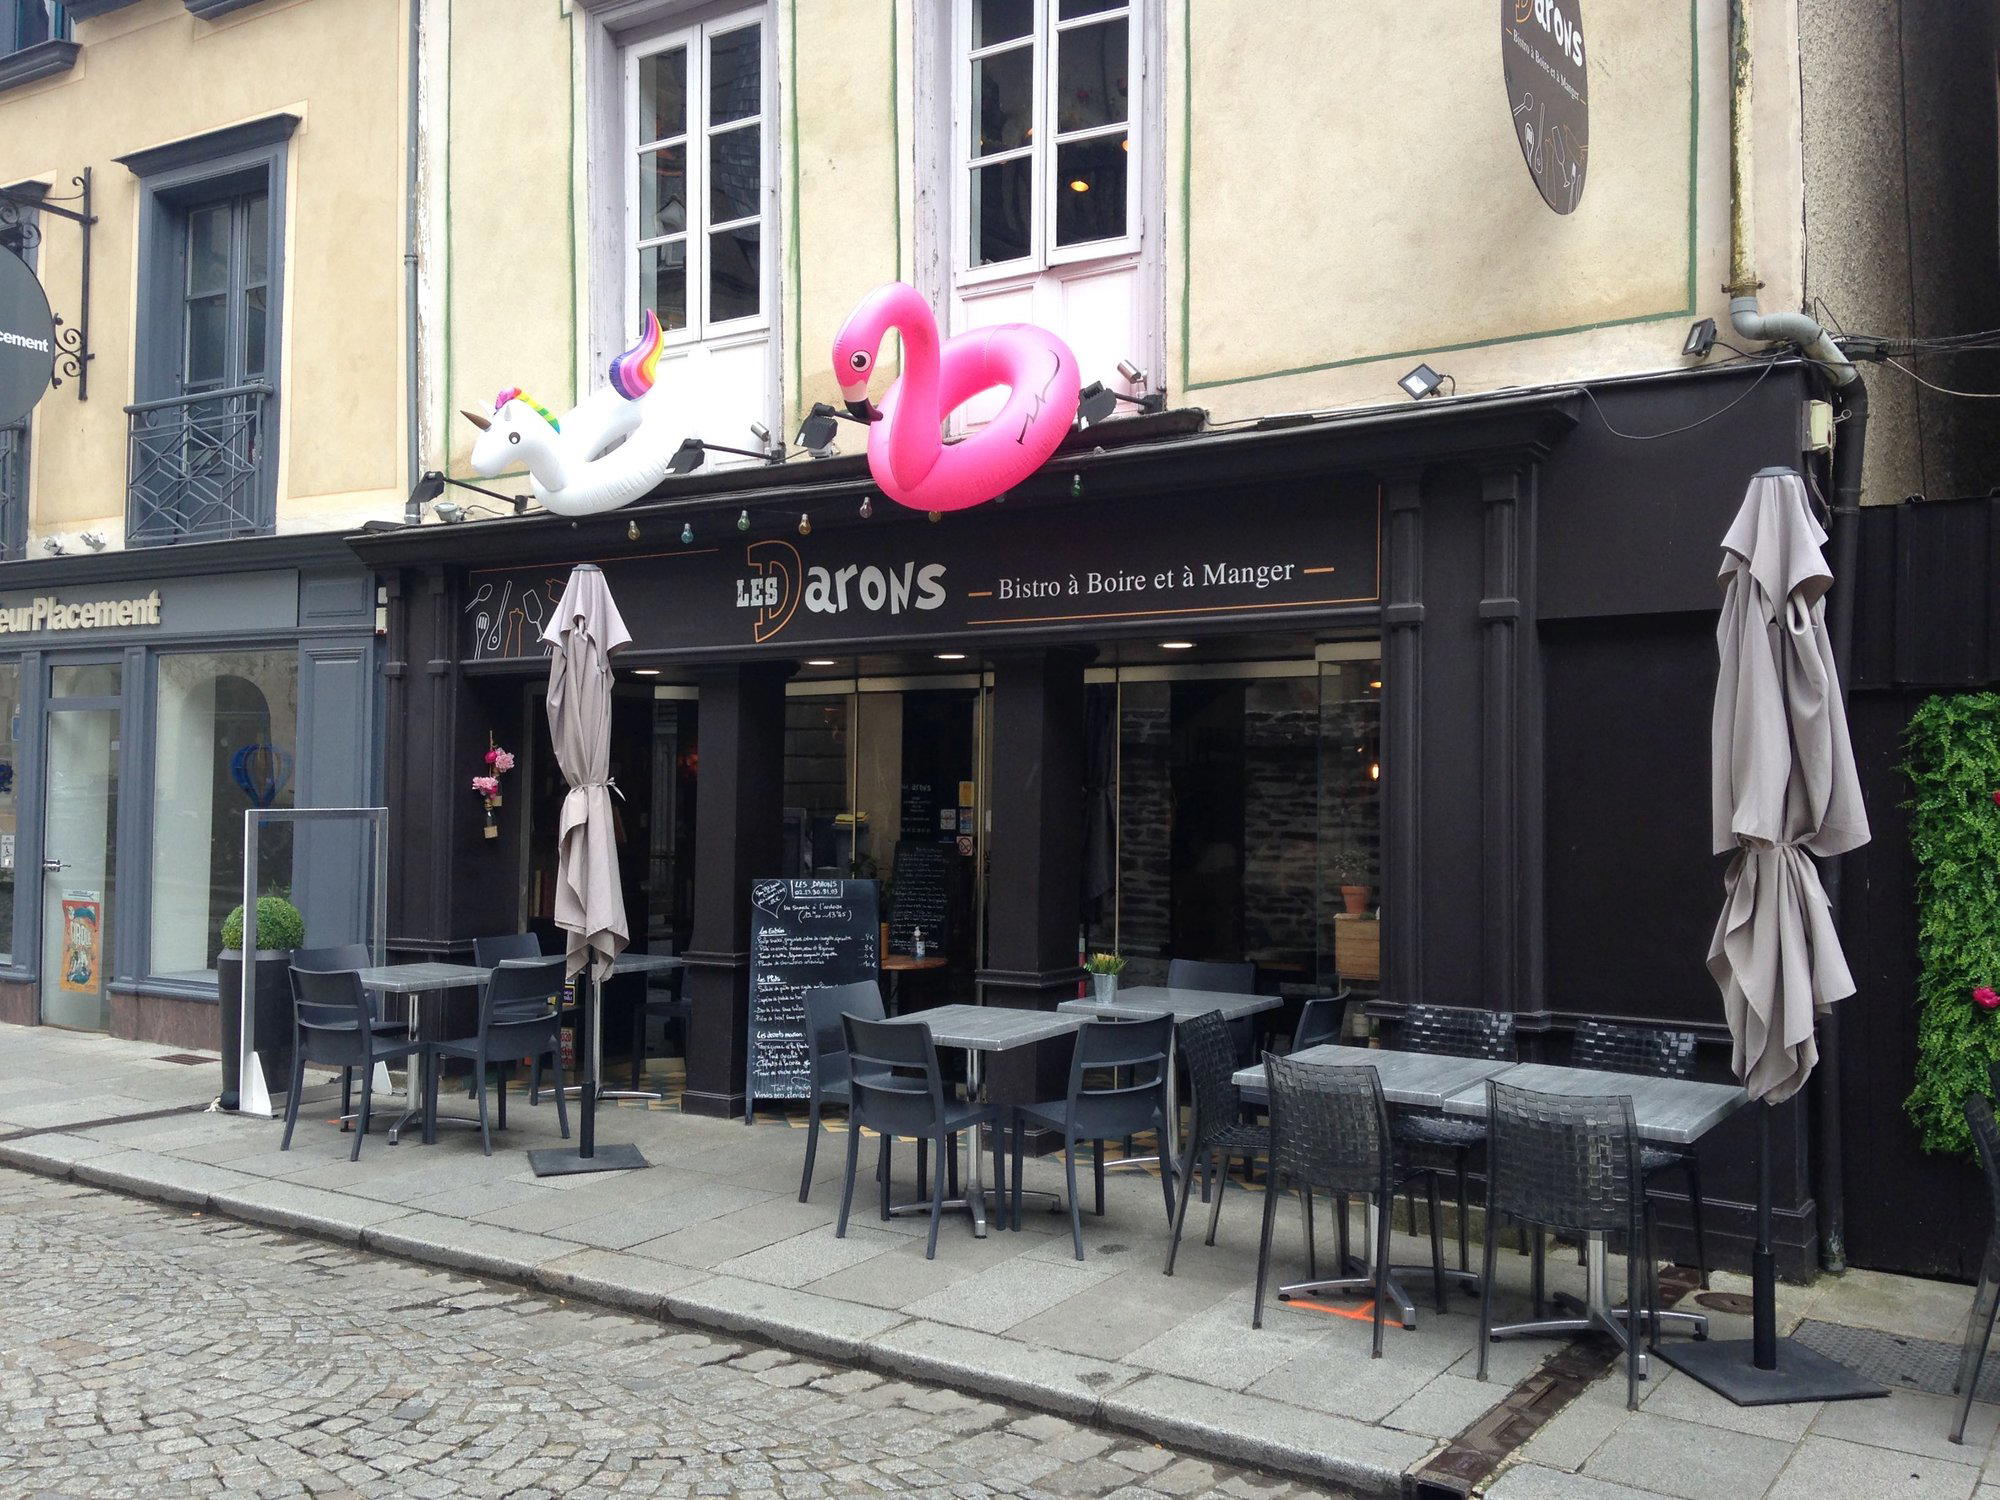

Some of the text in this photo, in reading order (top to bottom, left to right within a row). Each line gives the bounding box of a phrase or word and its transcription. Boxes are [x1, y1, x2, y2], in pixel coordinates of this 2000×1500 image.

[1513, 29, 1529, 54] Bistro
[1535, 50, 1549, 73] Boire
[1561, 74, 1579, 101] Manger
[736, 577, 778, 608] LES
[999, 562, 1295, 600] Bistro à Boire et à Manger
[0, 589, 161, 634] eurPlacement
